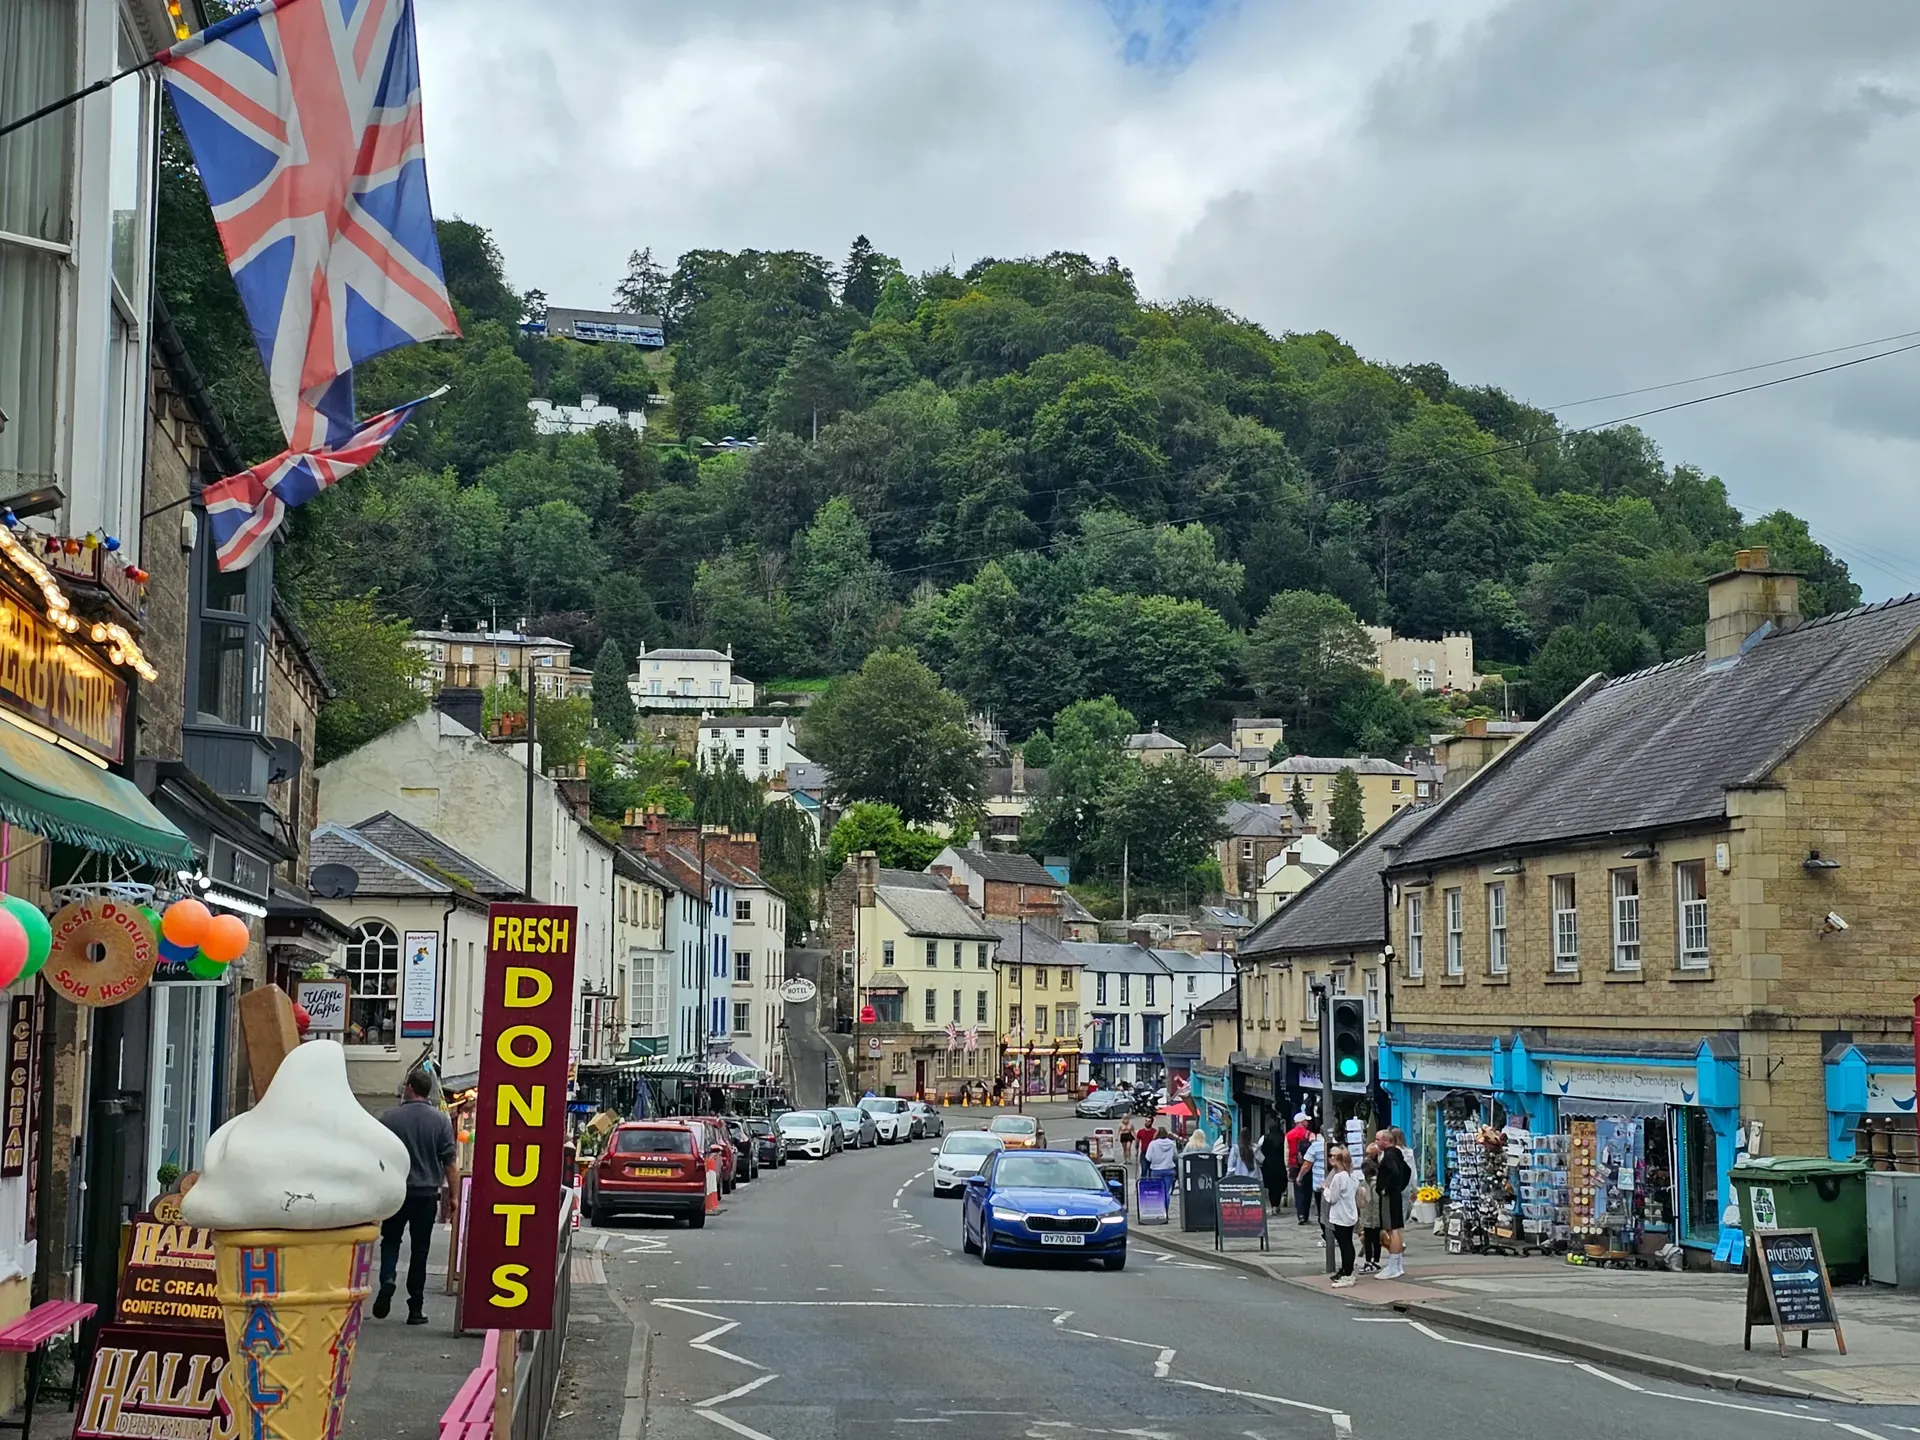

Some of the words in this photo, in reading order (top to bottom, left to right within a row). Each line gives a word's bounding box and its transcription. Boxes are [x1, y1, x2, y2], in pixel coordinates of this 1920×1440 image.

[0, 596, 115, 749] ERBYSHIRE
[52, 907, 93, 951] Fresh
[101, 904, 150, 960] Donuts
[492, 917, 569, 953] FRESH
[156, 961, 187, 976] Coffee
[55, 969, 90, 998] Sold
[99, 975, 138, 999] Here
[303, 989, 344, 1005] Wiffle
[303, 1001, 342, 1018] Waffle
[13, 1000, 30, 1062] ICE
[1570, 1067, 1596, 1082] Eclectic
[1596, 1069, 1624, 1087] Delights
[1624, 1069, 1633, 1083] of
[1634, 1070, 1680, 1093] Serendipity
[4, 1067, 26, 1169] CREAM
[488, 966, 553, 1309] DONUTS
[161, 1205, 183, 1220] Fre
[1766, 1247, 1815, 1262] RIVERSIDE
[135, 1277, 161, 1293] ICE
[164, 1279, 219, 1298] CREAM
[122, 1299, 224, 1319] CONFECTIONERY
[77, 1347, 240, 1440] HALL'S
[117, 1412, 211, 1439] DERBYSHIRE
